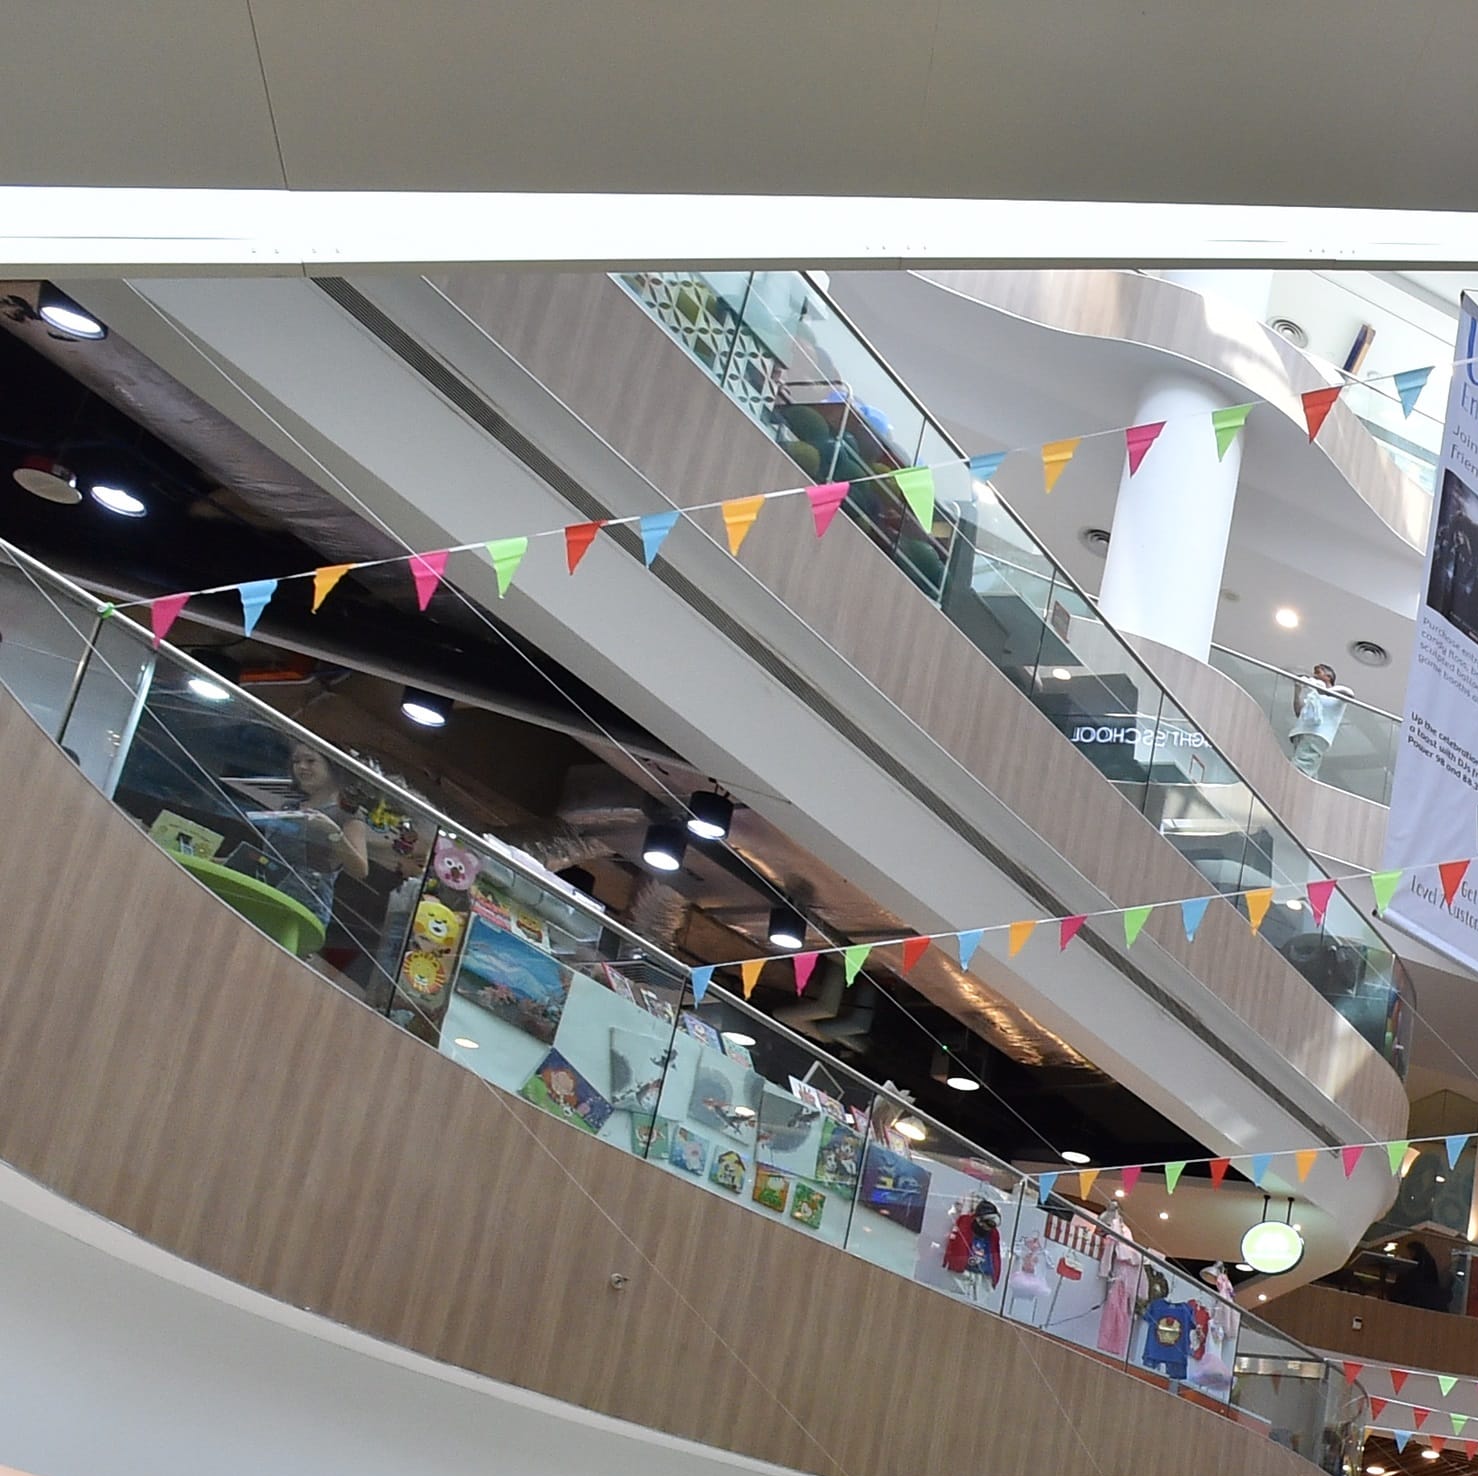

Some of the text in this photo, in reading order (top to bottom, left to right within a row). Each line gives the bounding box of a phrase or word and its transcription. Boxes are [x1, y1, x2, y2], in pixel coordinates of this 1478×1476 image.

[1453, 425, 1478, 455] Join
[1421, 630, 1446, 653] candy
[1423, 617, 1460, 648] Purchase
[1420, 641, 1455, 672] sculpted
[1418, 654, 1442, 676] game
[1443, 670, 1471, 697] booths
[1411, 711, 1423, 725] Up
[1425, 720, 1437, 736] the
[1408, 735, 1433, 758] Power
[1446, 764, 1461, 778] and
[1417, 727, 1437, 748] toast
[1439, 746, 1456, 762] with
[1457, 758, 1471, 773] DJs
[1411, 875, 1438, 905] Level
[1461, 881, 1478, 905] Get
